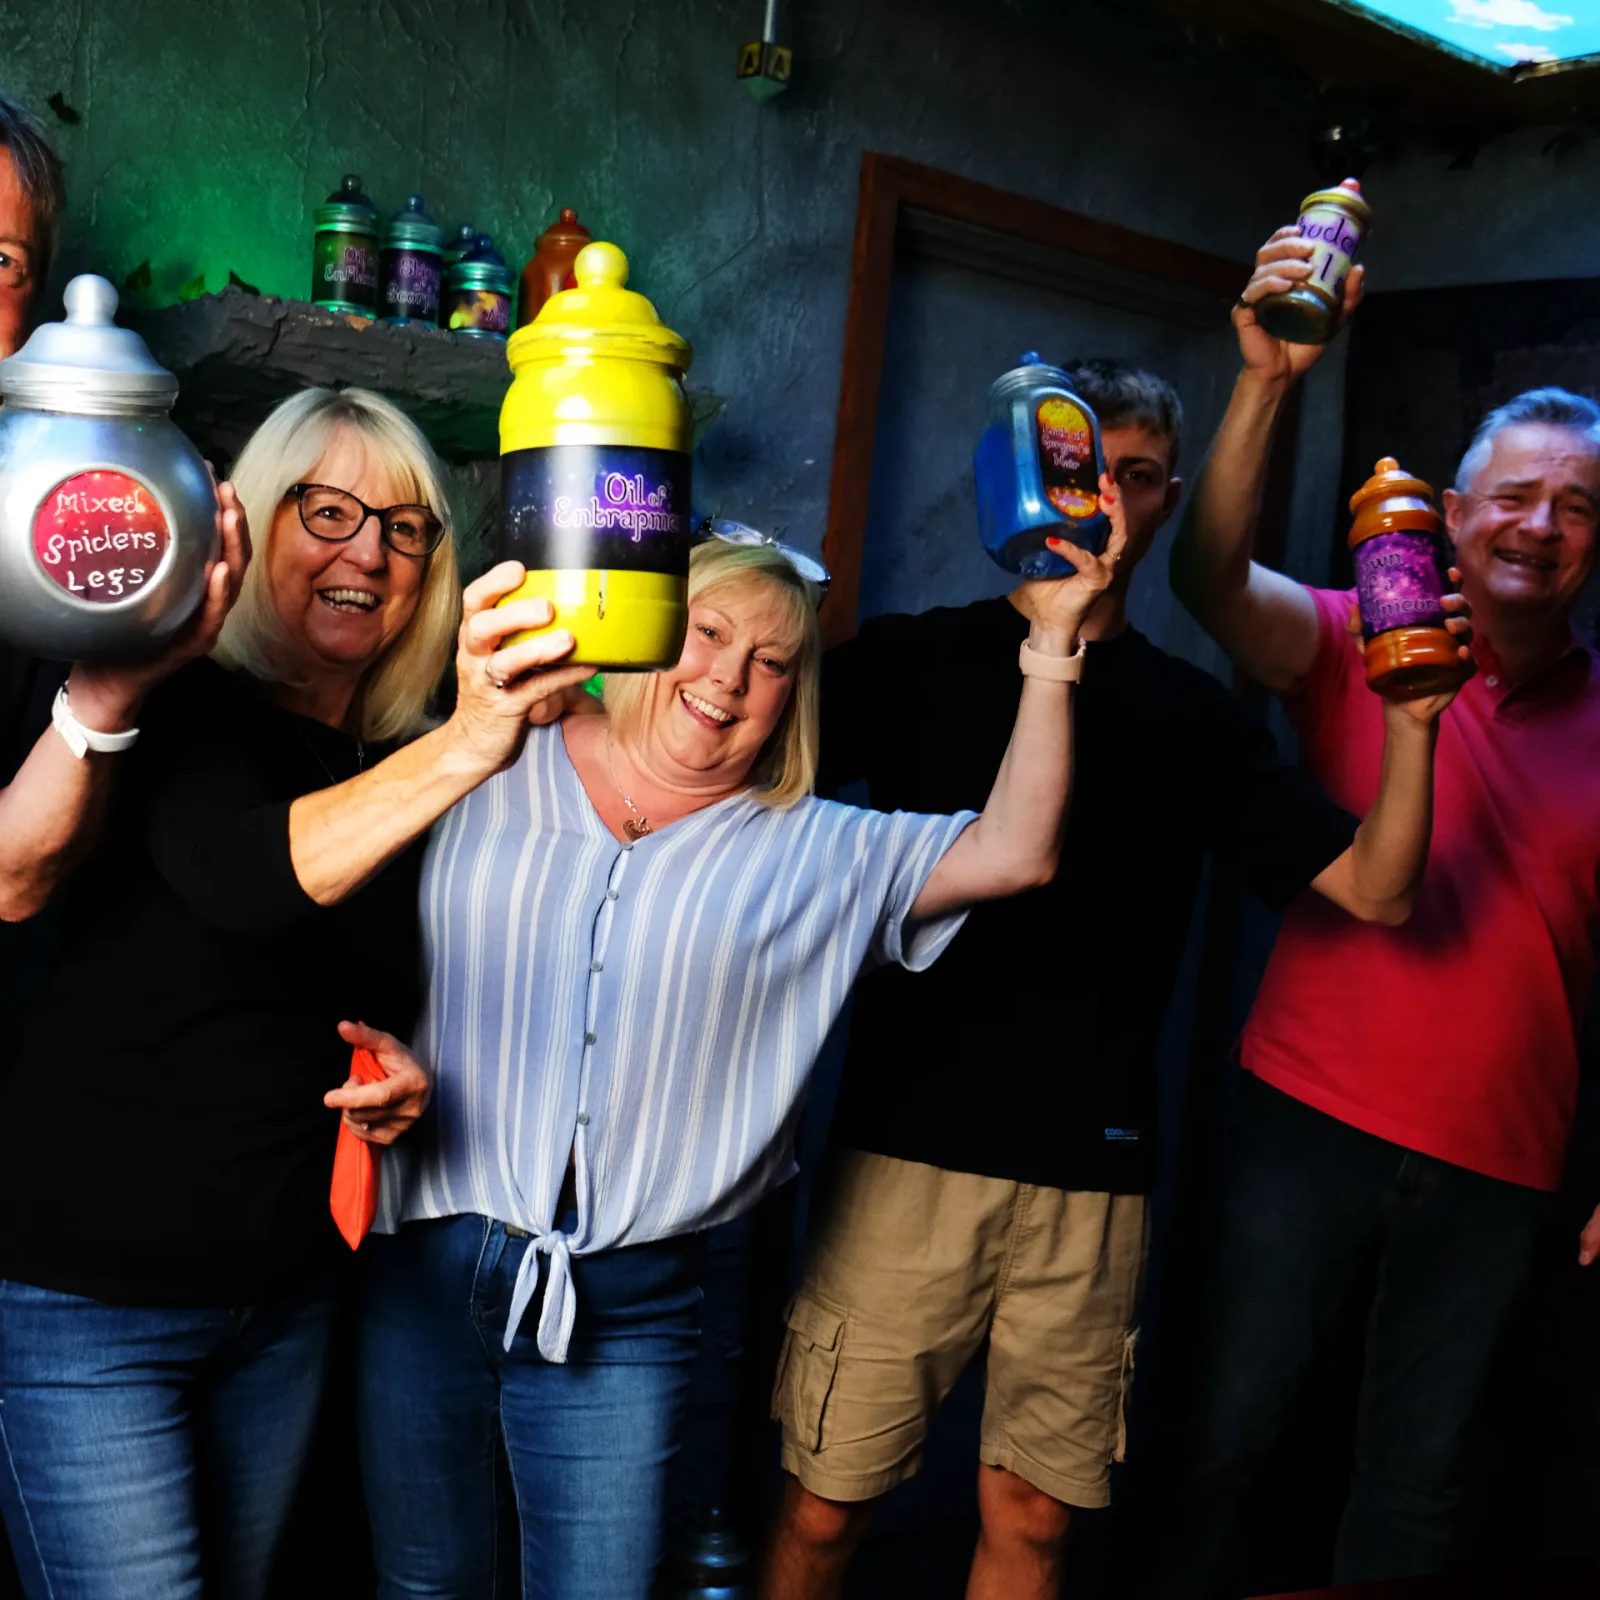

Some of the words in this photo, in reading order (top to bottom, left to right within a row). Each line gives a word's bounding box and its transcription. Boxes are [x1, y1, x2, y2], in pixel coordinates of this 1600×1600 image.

[53, 489, 147, 518] Mixed
[604, 472, 646, 505] Oil
[647, 485, 667, 508] of
[43, 524, 157, 565] Spiders
[67, 567, 146, 596] Legs
